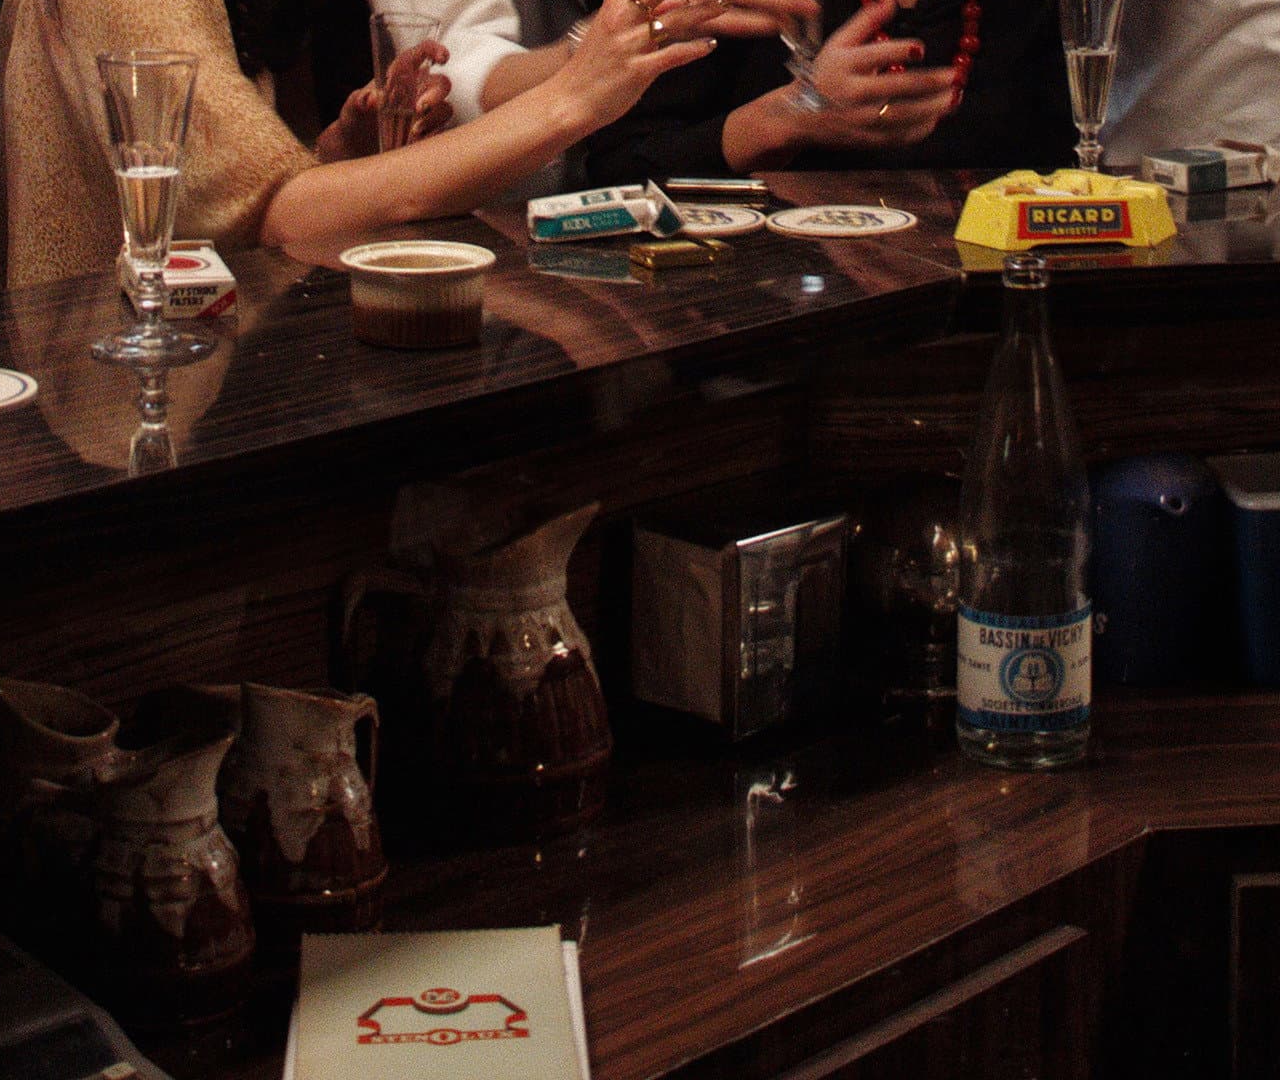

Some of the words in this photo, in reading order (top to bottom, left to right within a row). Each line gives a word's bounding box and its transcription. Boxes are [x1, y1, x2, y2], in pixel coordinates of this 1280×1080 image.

[1031, 208, 1116, 223] RICARD
[979, 627, 1031, 649] BASSIN
[1048, 623, 1084, 648] VICHY
